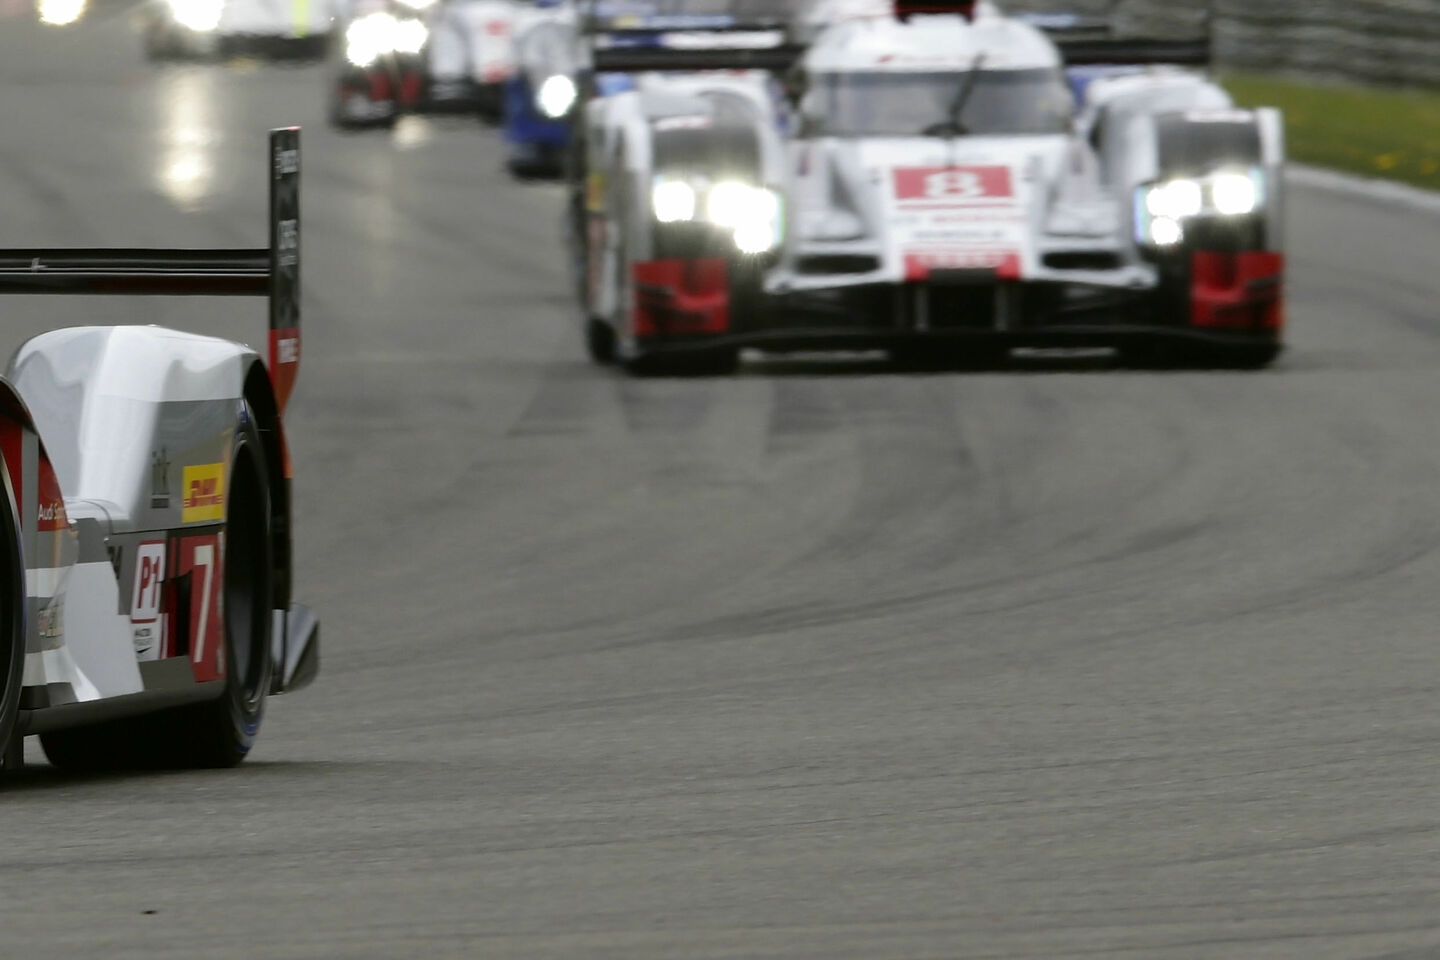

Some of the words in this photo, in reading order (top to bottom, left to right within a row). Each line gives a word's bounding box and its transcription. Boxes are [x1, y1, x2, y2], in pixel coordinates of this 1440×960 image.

[926, 171, 983, 198] 8
[38, 504, 53, 520] Audi
[137, 555, 161, 609] P1
[193, 545, 215, 663] 7
